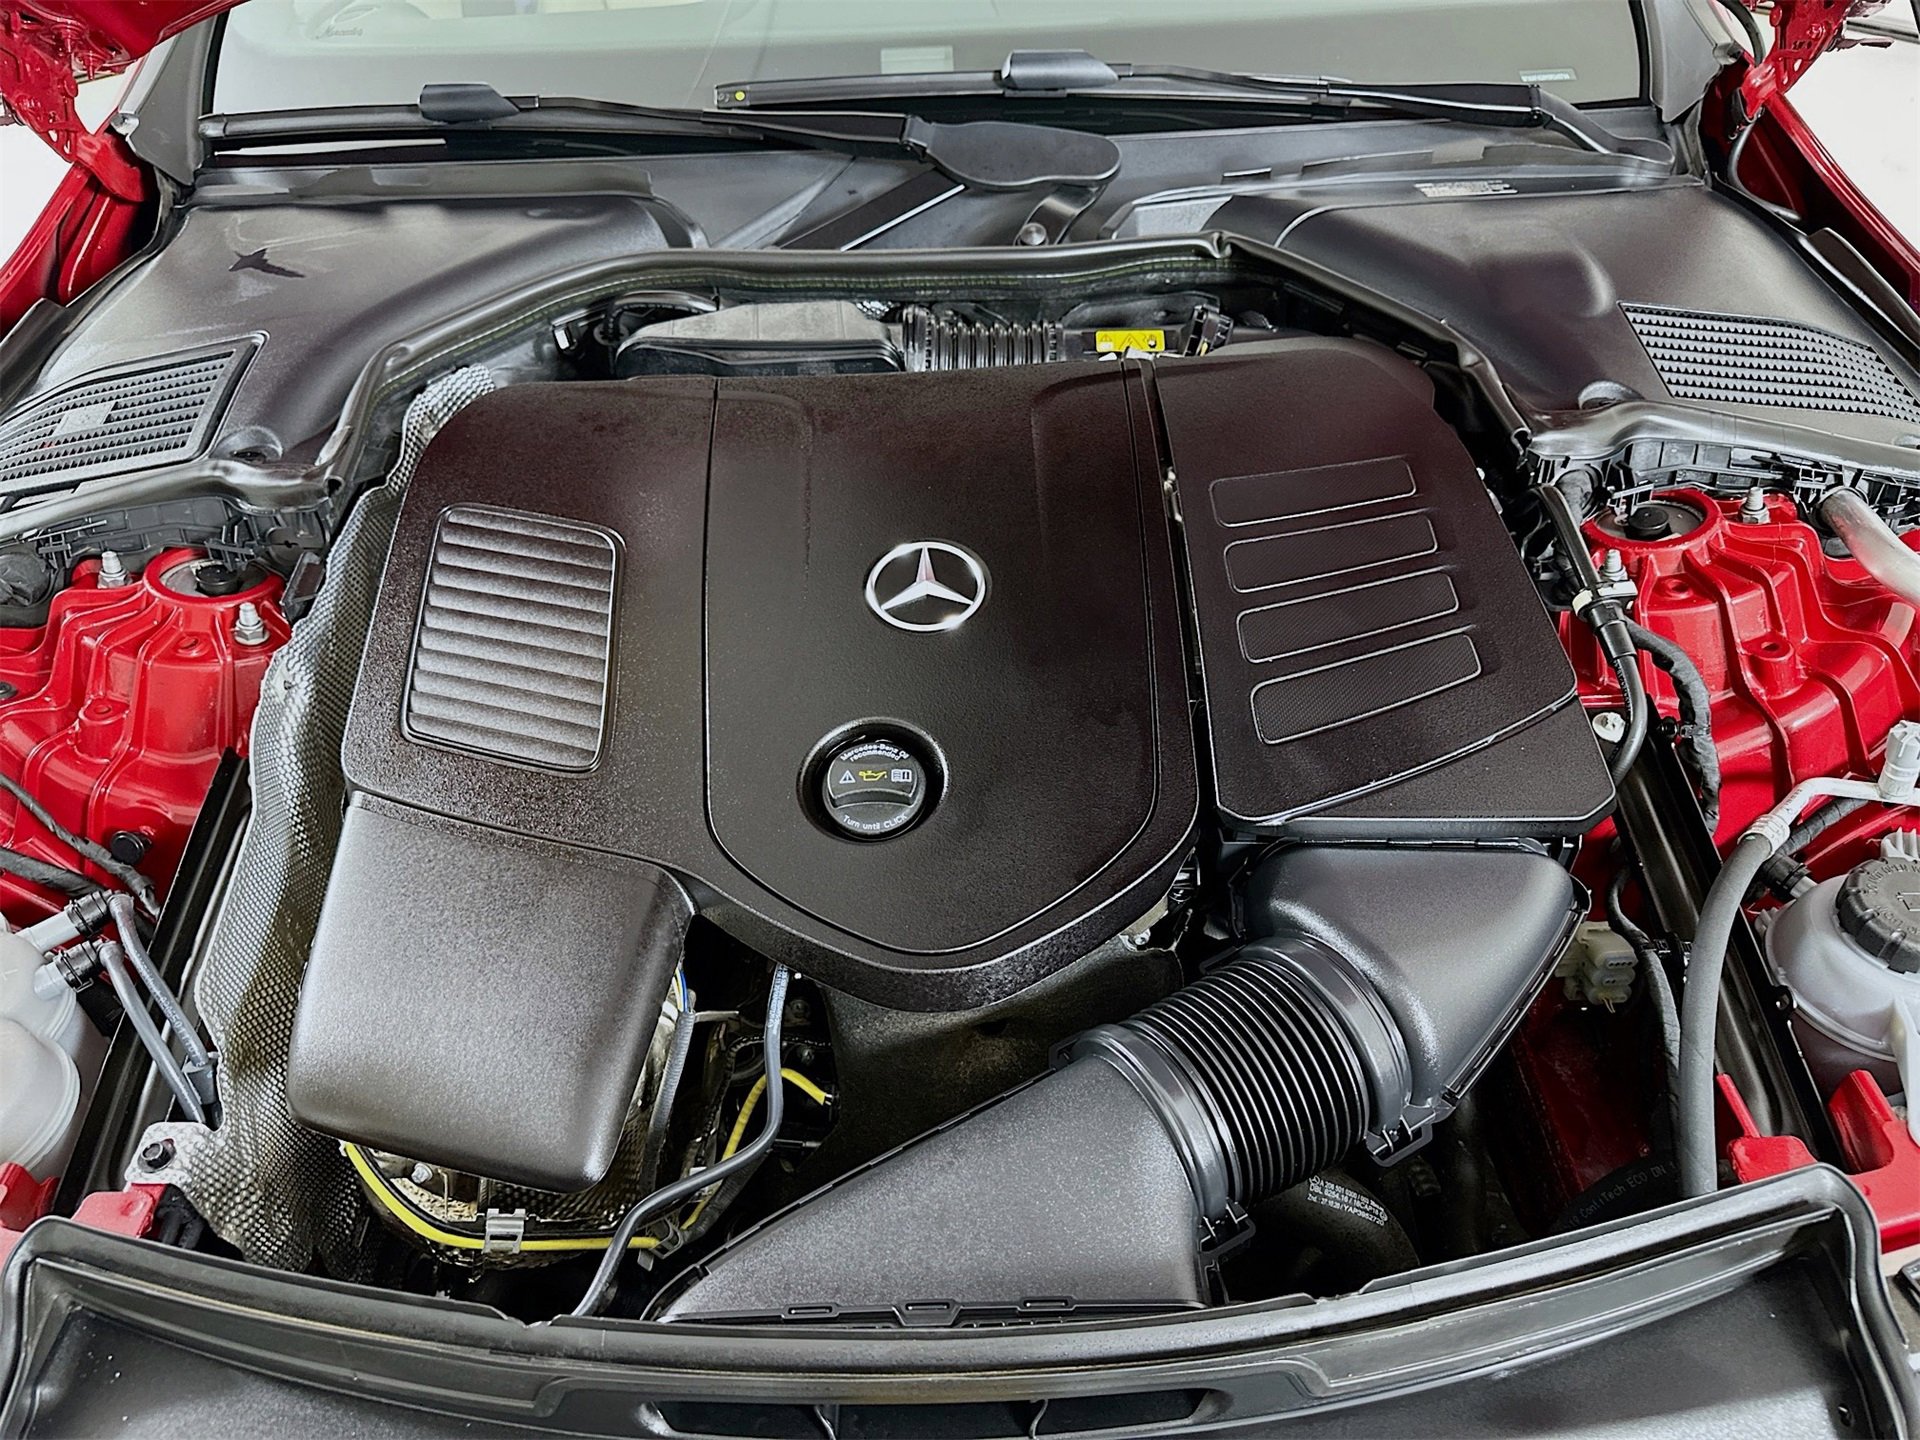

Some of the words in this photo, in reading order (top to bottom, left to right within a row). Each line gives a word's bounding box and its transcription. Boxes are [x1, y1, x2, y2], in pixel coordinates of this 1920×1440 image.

[840, 743, 899, 761] Mercedes-Benz
[849, 749, 901, 762] recommended
[842, 814, 860, 829] Turn
[862, 822, 881, 831] until
[884, 813, 908, 829] CLICK
